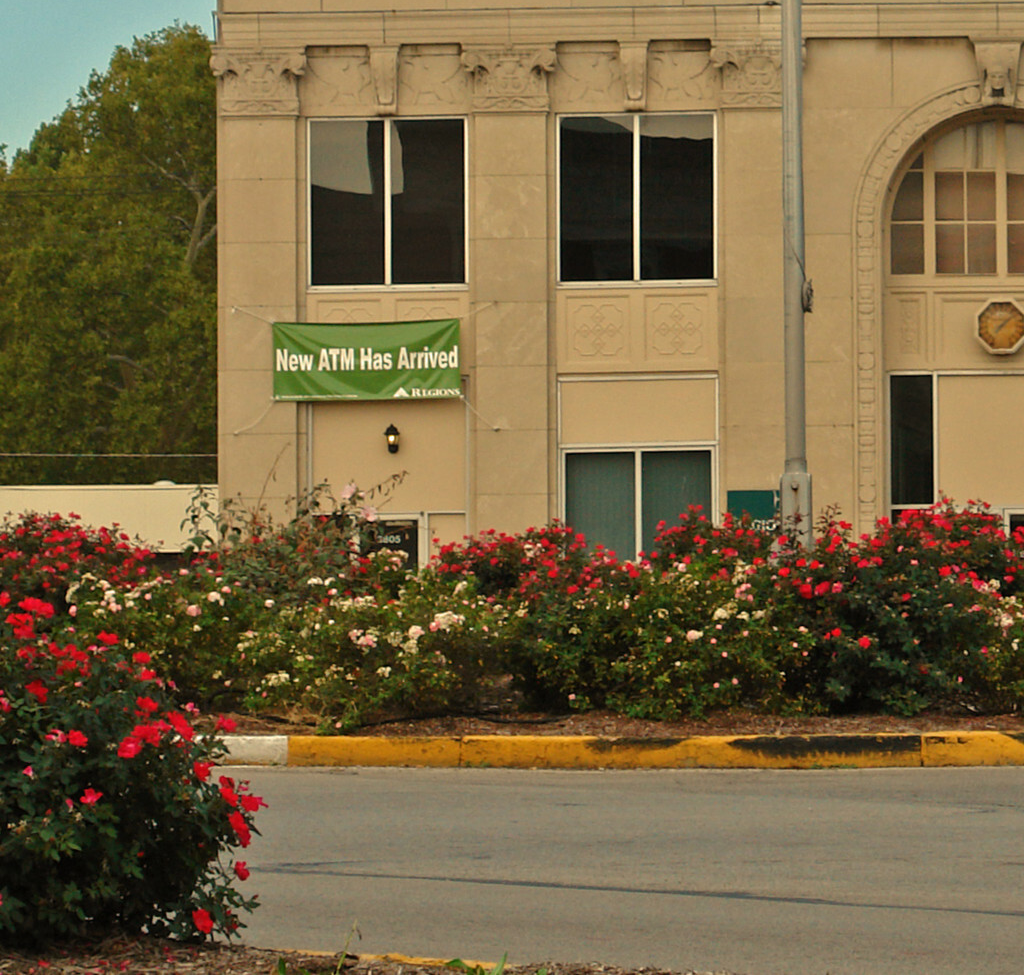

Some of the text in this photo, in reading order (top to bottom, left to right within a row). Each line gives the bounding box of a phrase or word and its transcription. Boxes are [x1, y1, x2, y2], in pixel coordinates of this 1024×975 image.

[276, 345, 458, 372] New ATM Has Arrived
[411, 387, 460, 397] REGIONS
